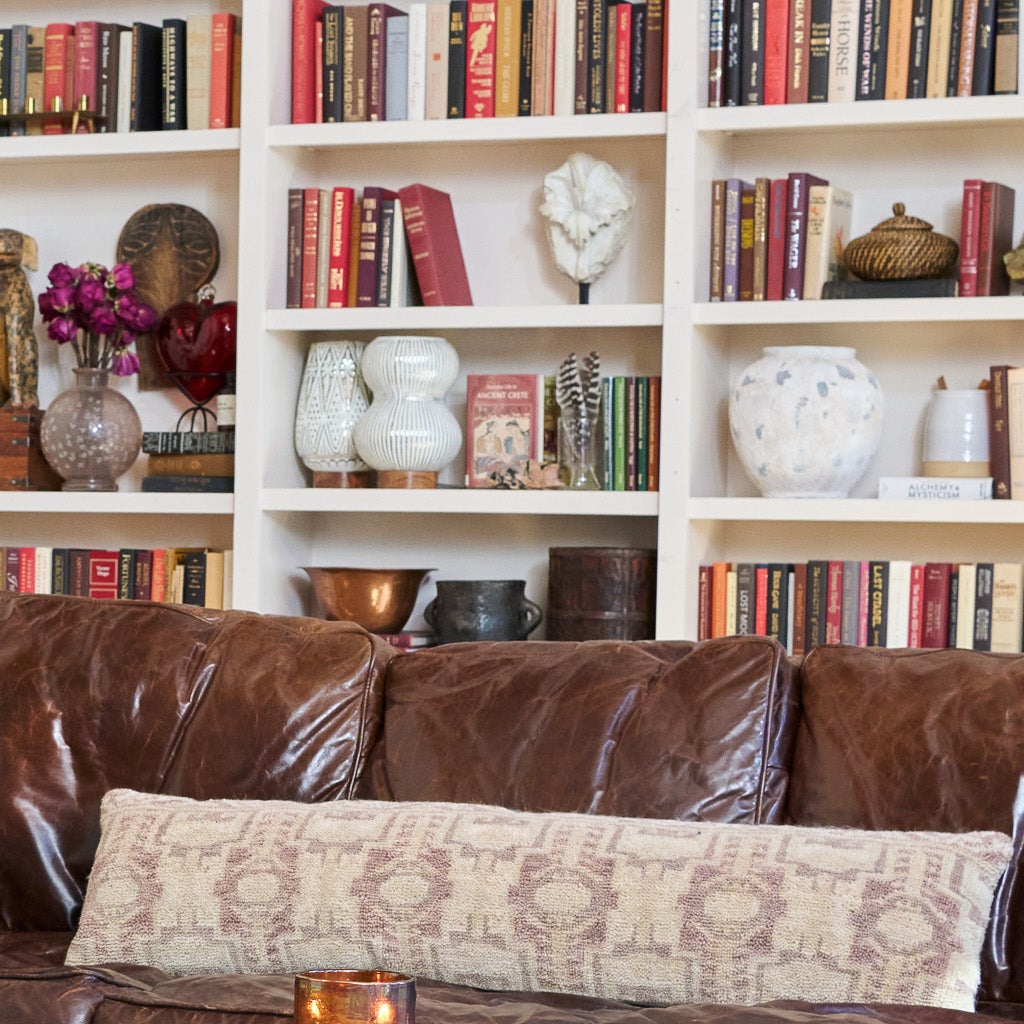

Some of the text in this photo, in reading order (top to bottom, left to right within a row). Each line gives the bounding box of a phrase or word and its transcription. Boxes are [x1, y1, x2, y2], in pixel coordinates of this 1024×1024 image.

[835, 20, 850, 77] HORSE
[860, 12, 872, 95] WINDS OF WAR
[789, 233, 800, 268] WAGER
[739, 590, 749, 611] LOST
[871, 565, 883, 627] LAST CITADEL
